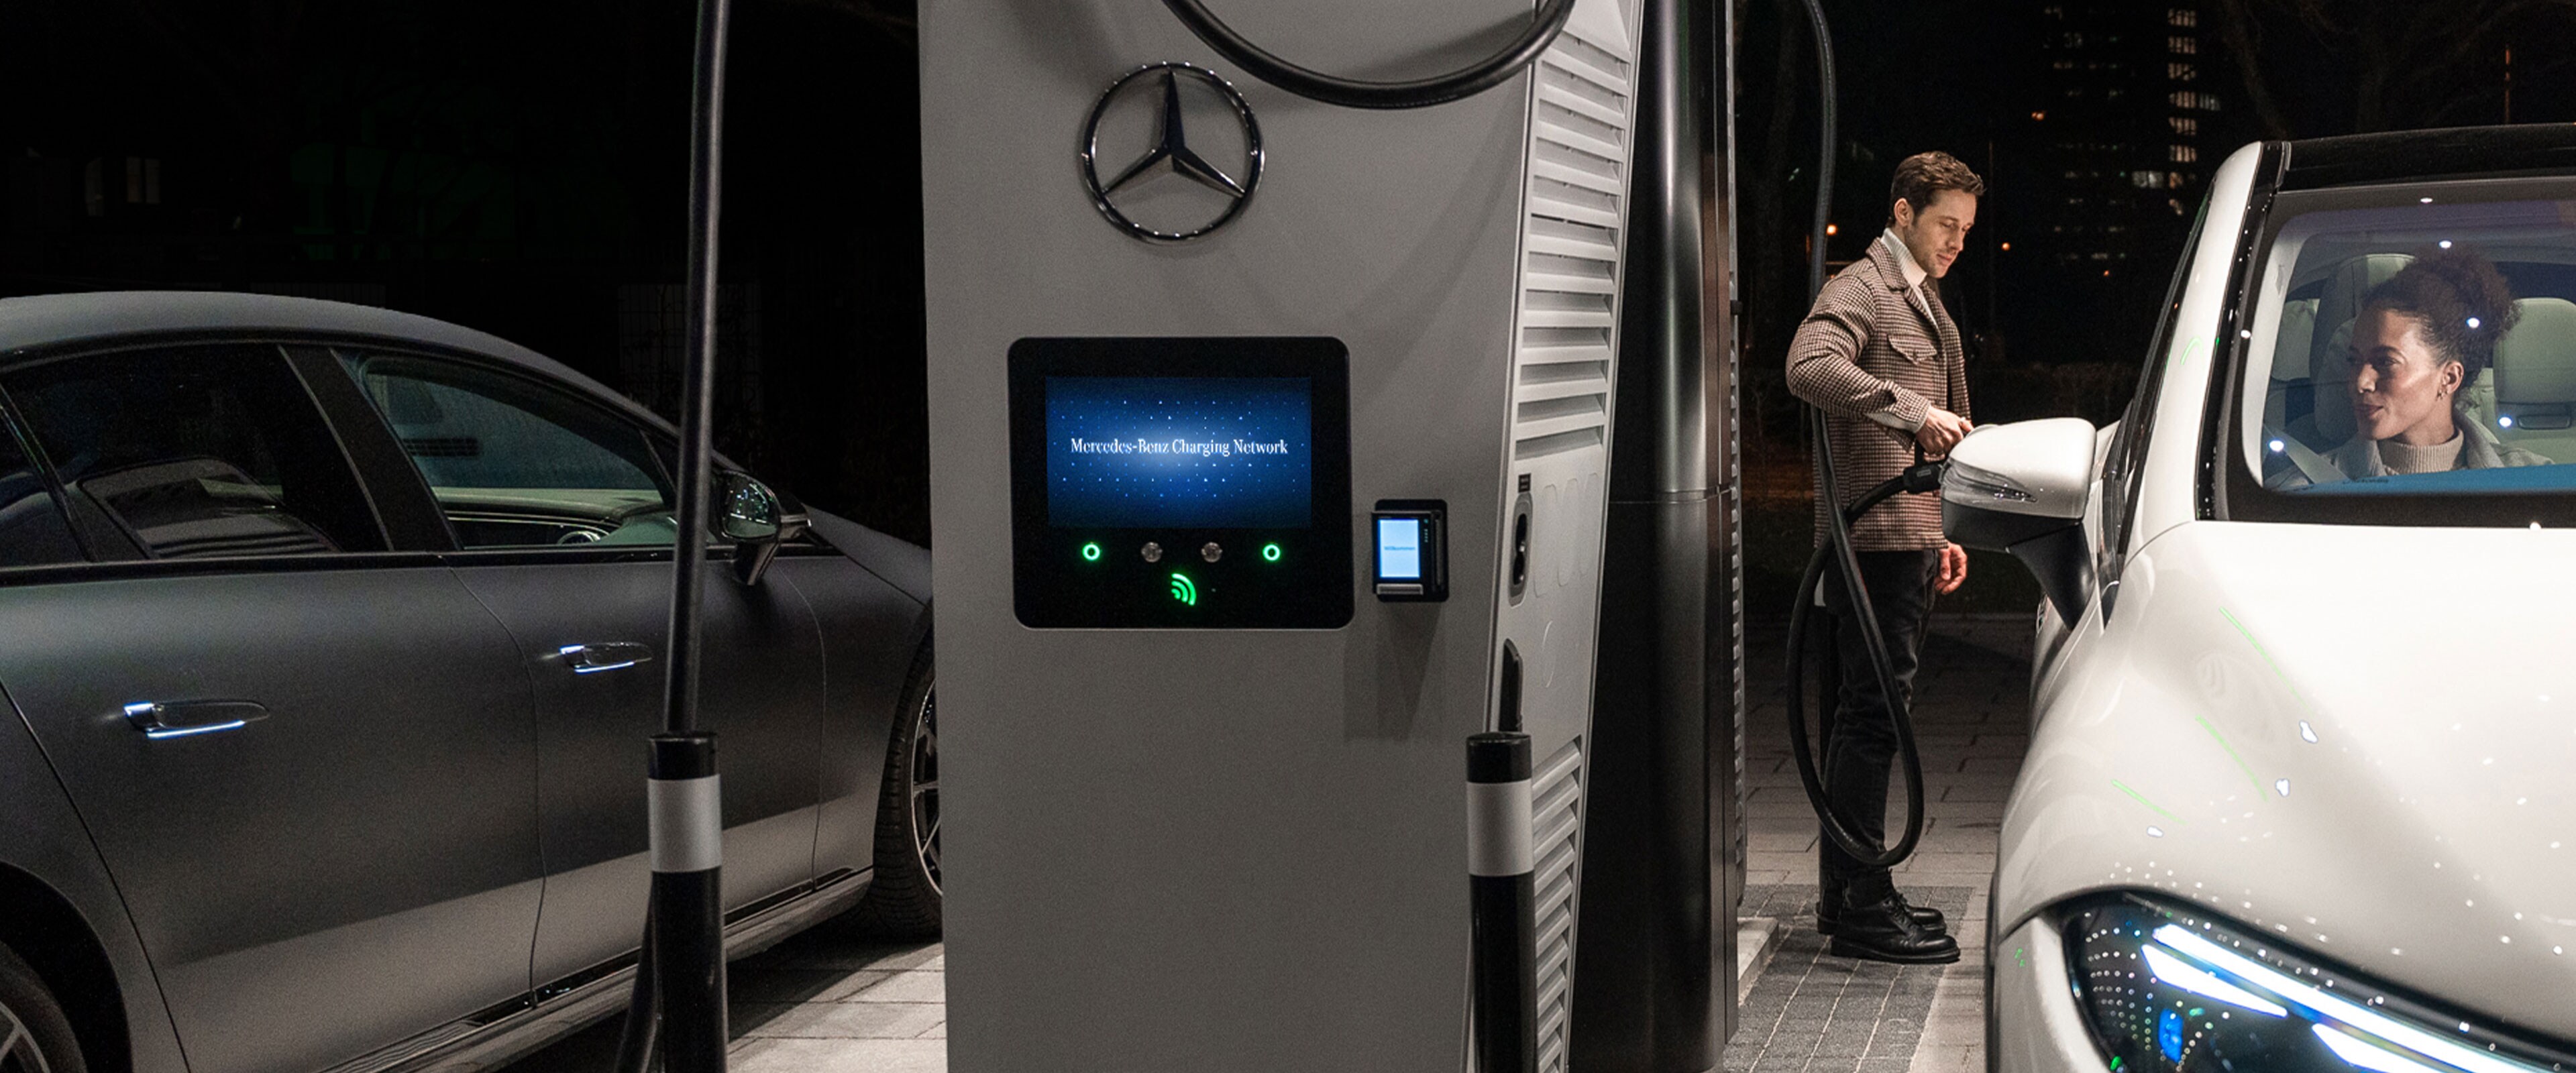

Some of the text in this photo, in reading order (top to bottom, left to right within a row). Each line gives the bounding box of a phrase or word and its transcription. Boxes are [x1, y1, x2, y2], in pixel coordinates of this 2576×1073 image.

[1071, 438, 1288, 457] Mercedes-Benz Charging Network
